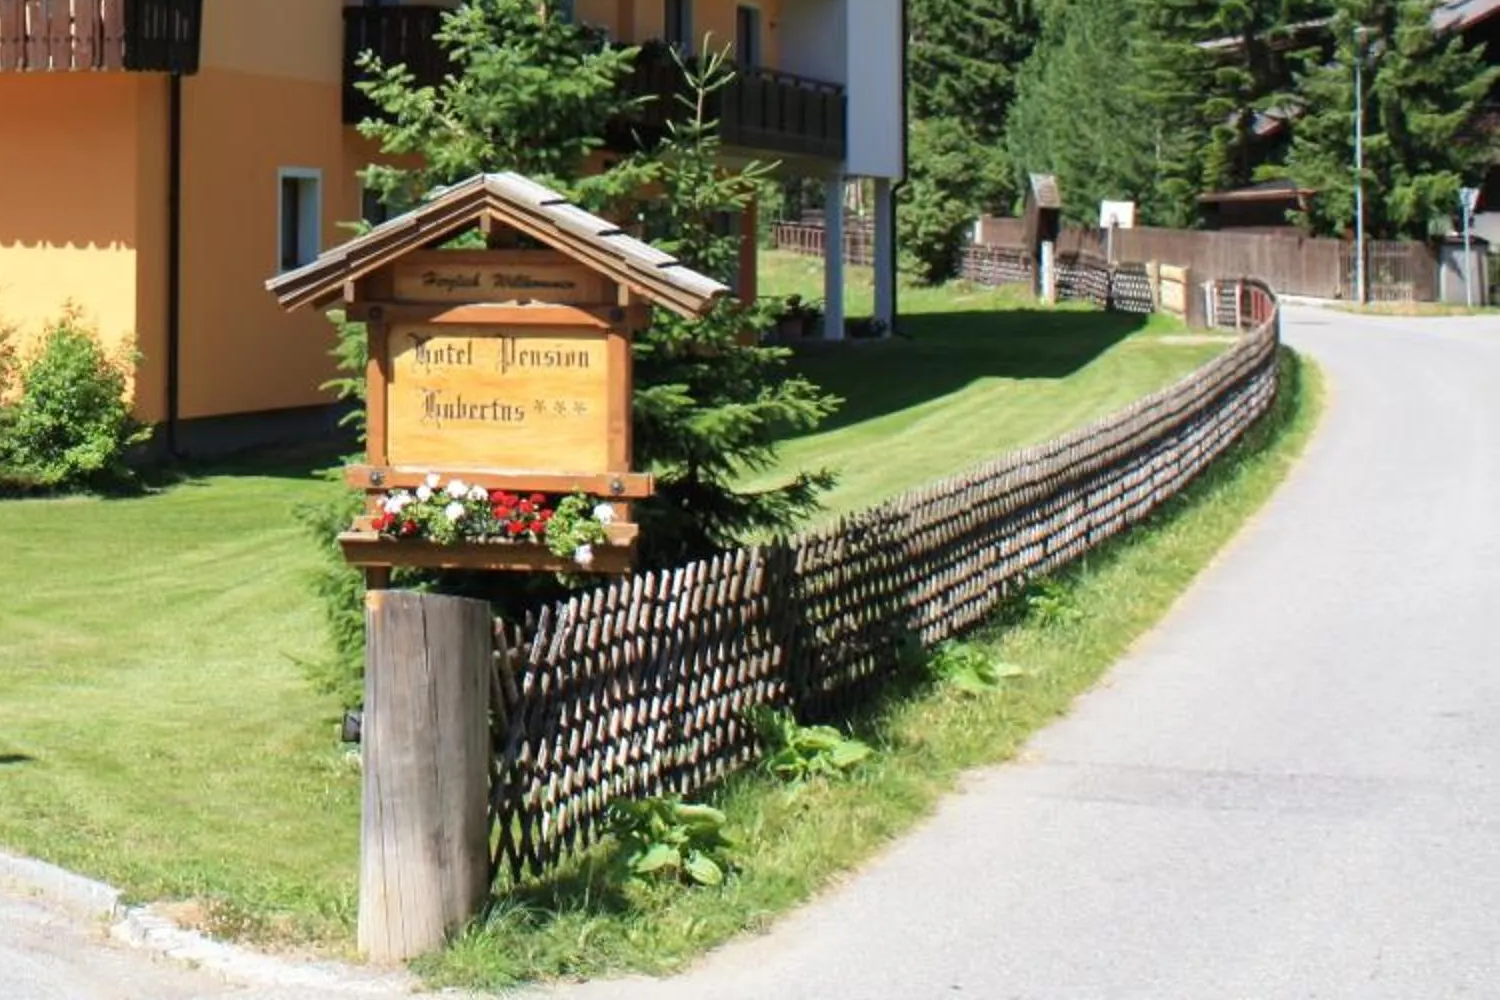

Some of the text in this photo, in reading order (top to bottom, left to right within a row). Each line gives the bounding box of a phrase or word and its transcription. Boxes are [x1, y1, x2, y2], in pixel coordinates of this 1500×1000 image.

[409, 333, 590, 374] Hotel Pension
[421, 387, 525, 429] Hubertus
